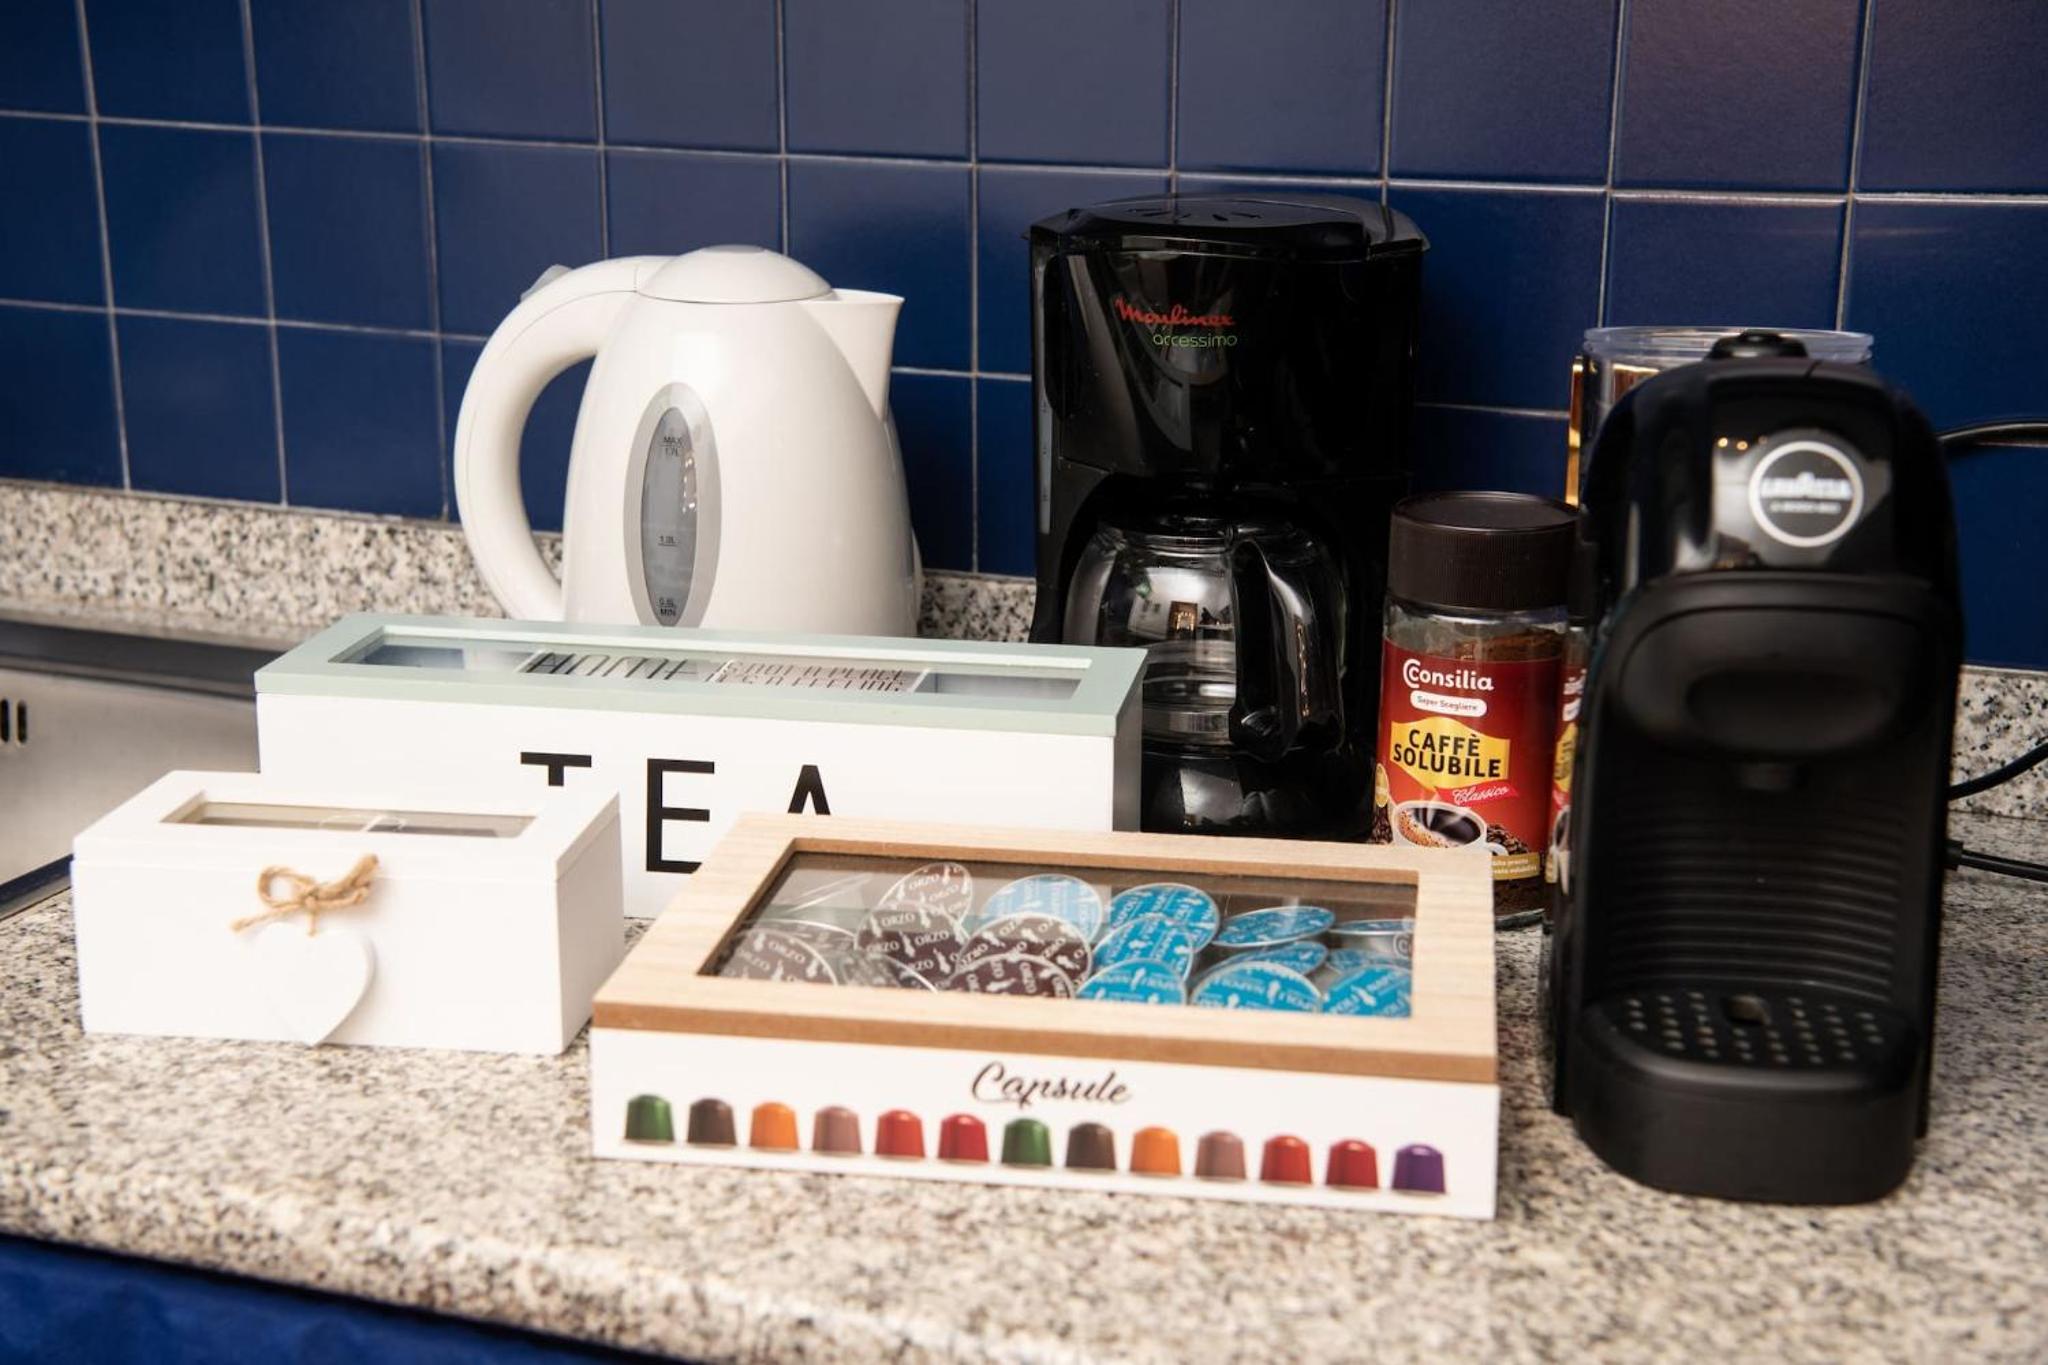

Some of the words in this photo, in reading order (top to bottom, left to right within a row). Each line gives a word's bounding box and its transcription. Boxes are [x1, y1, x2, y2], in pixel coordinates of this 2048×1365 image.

[1115, 296, 1235, 326] Moulinex
[1153, 333, 1238, 348] accessimo
[1403, 658, 1495, 691] Consilia
[1409, 728, 1480, 757] CAFFÈ
[1393, 743, 1501, 778] SOLUBILE
[1452, 785, 1511, 806] Classico
[881, 912, 915, 928] ORZO
[914, 930, 950, 946] ORZO
[768, 940, 806, 964] ORZO
[971, 1060, 1133, 1111] Capsule
